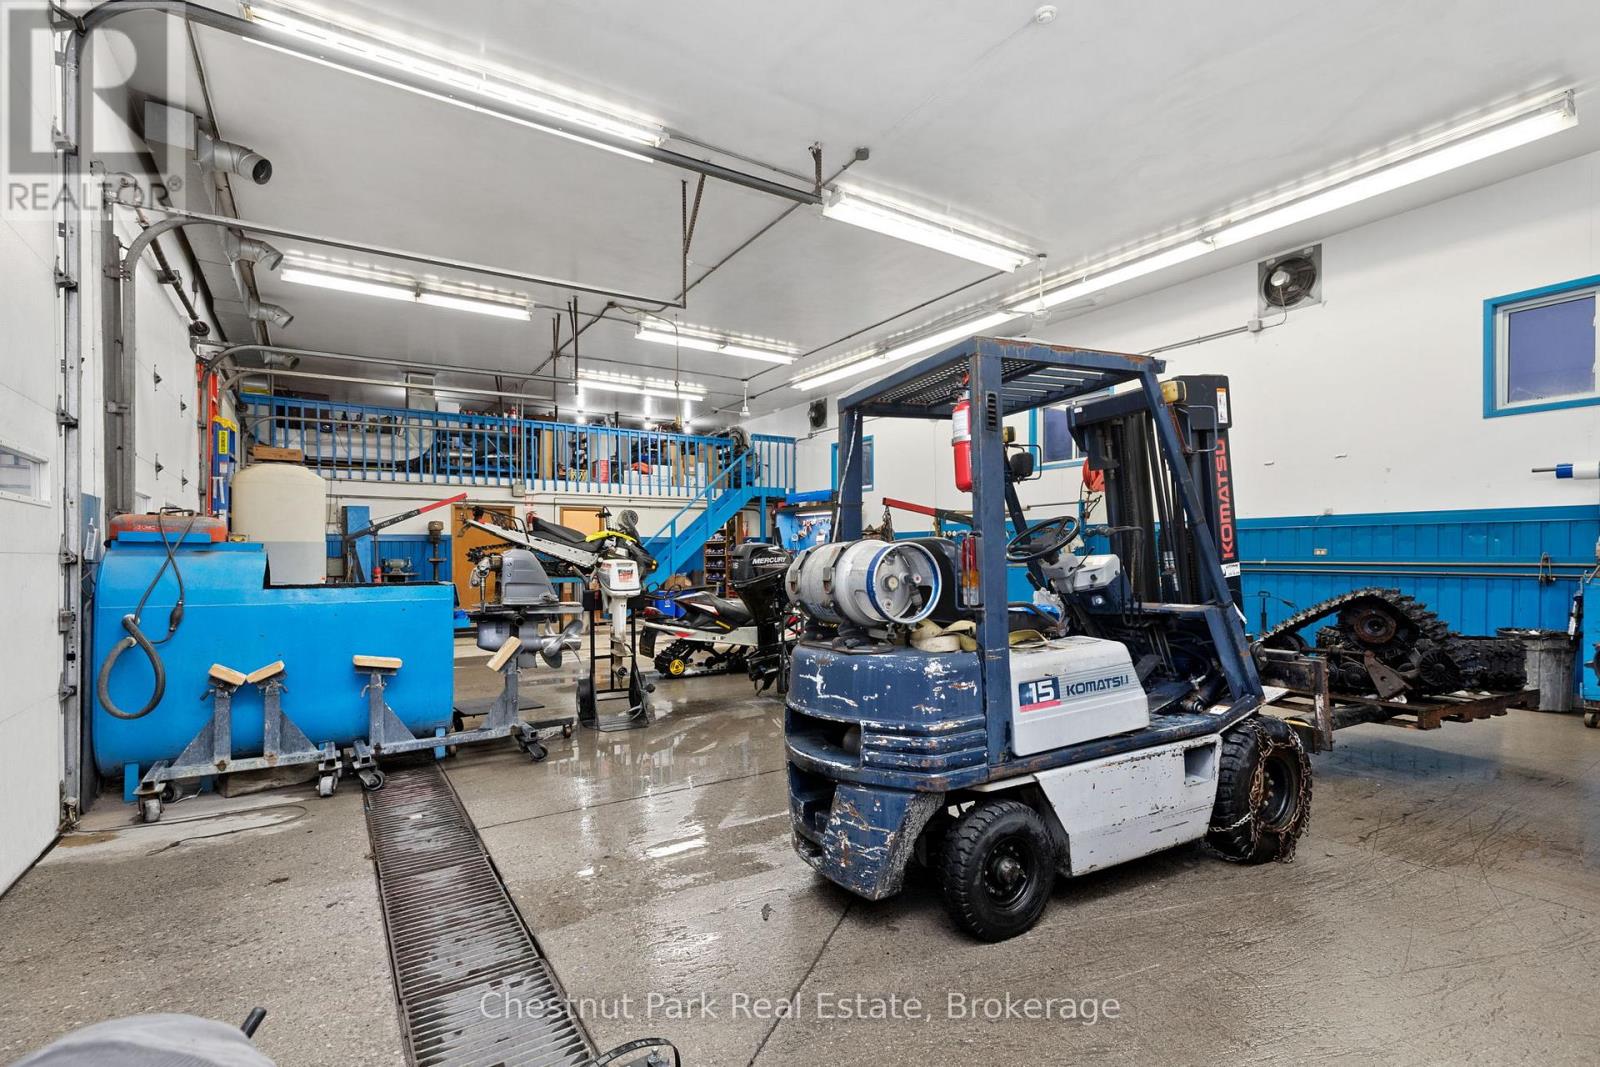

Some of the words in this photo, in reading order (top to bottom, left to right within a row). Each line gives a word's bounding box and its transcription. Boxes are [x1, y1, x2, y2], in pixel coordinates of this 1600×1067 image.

[1215, 438, 1234, 559] KOMATSU
[752, 557, 786, 565] MERCURY
[1029, 680, 1055, 704] 15
[1066, 675, 1129, 697] KOMATSU
